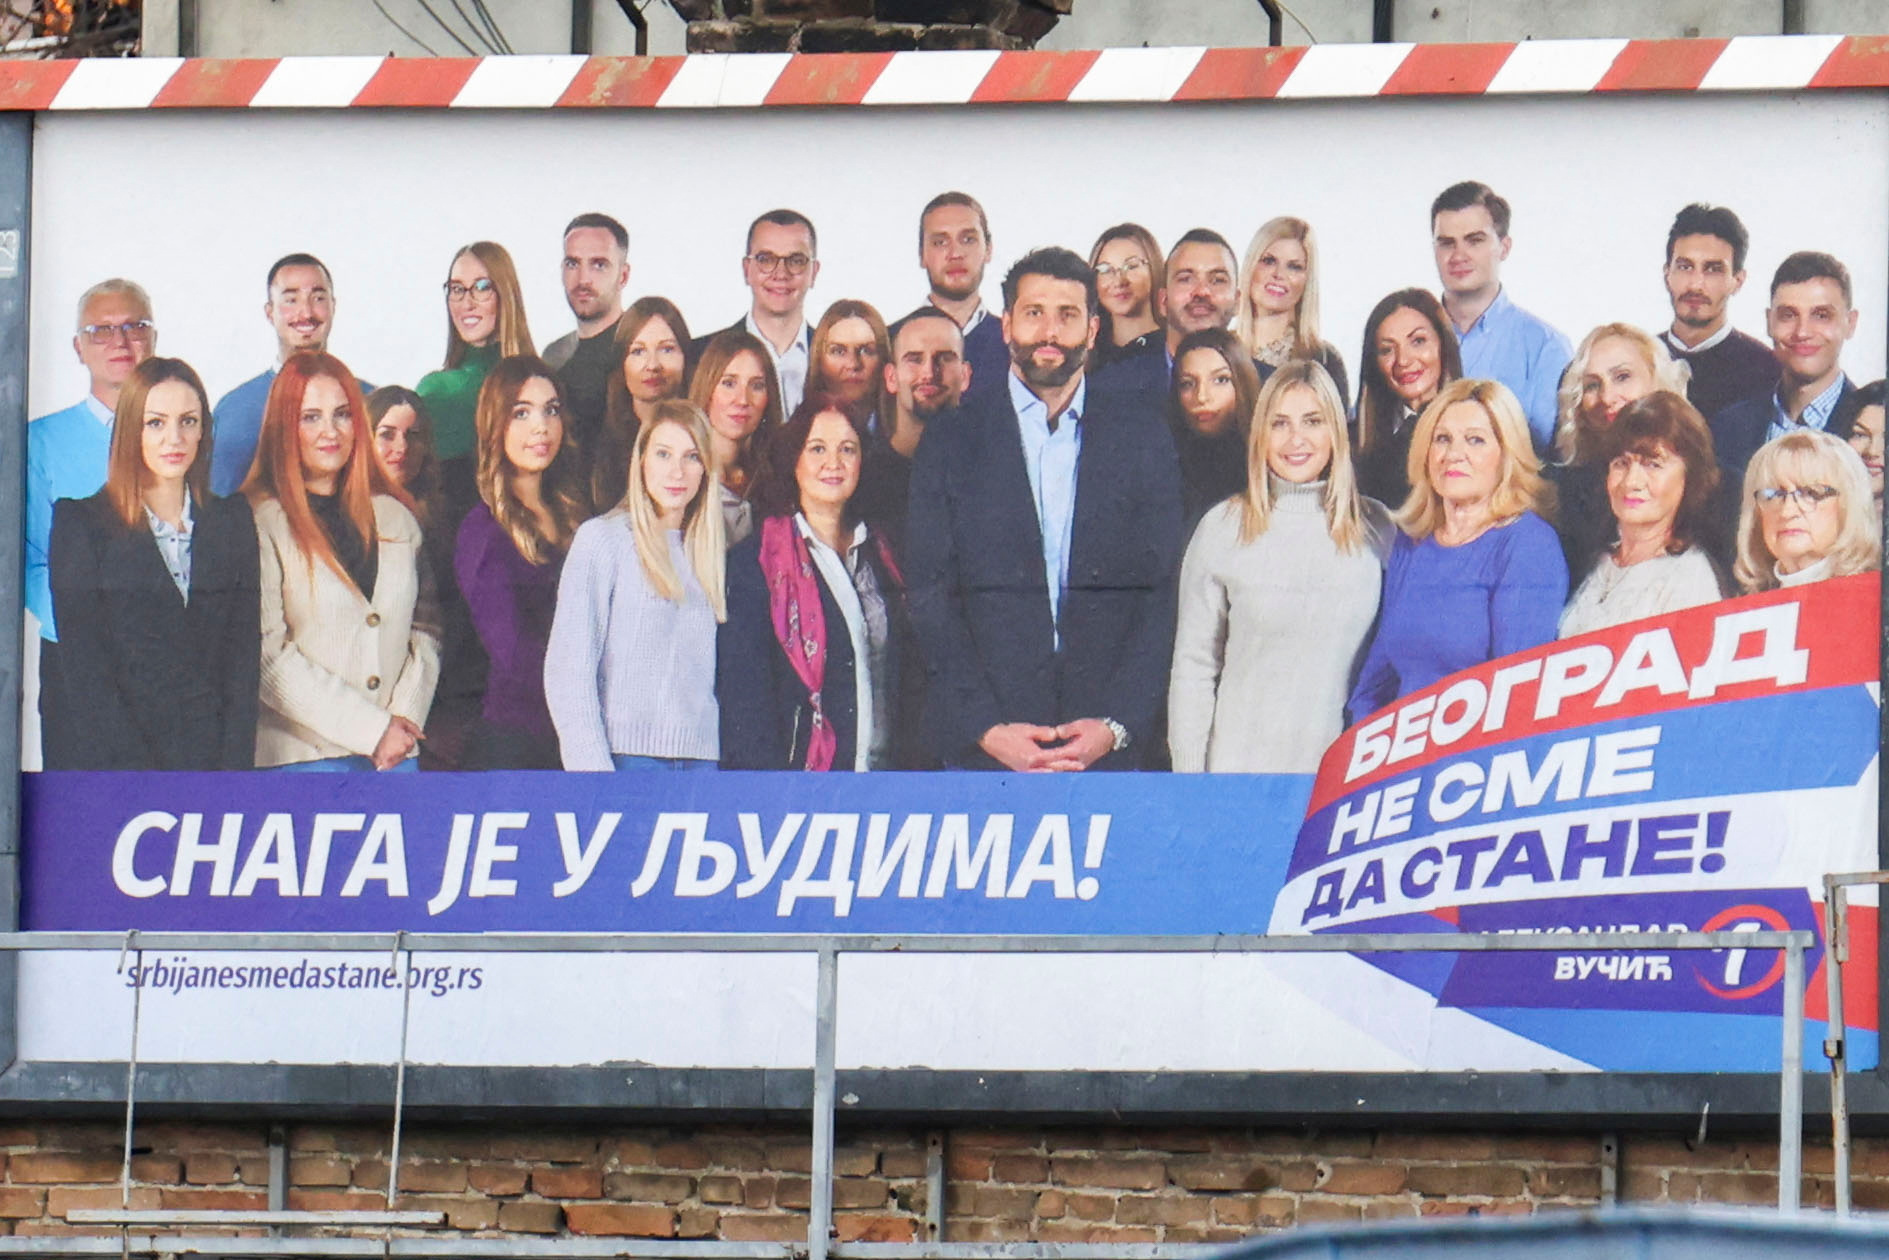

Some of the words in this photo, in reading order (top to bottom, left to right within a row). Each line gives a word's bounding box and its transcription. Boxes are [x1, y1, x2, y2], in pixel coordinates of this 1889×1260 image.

[1344, 601, 1810, 783] БЕОГРАД
[1327, 777, 1421, 855] НЕ
[1428, 725, 1662, 823] СМЕ
[112, 811, 409, 898] СНАГА
[427, 812, 530, 916] ЈЕ
[553, 812, 623, 898] У
[631, 812, 1112, 918] ЉУДИМА!
[1300, 859, 1387, 927] ДА
[1399, 811, 1731, 901] СТАНЕ!
[124, 956, 484, 998] srbijanesmedastane.org.rs
[1554, 955, 1673, 981] ВУЧИЋ
